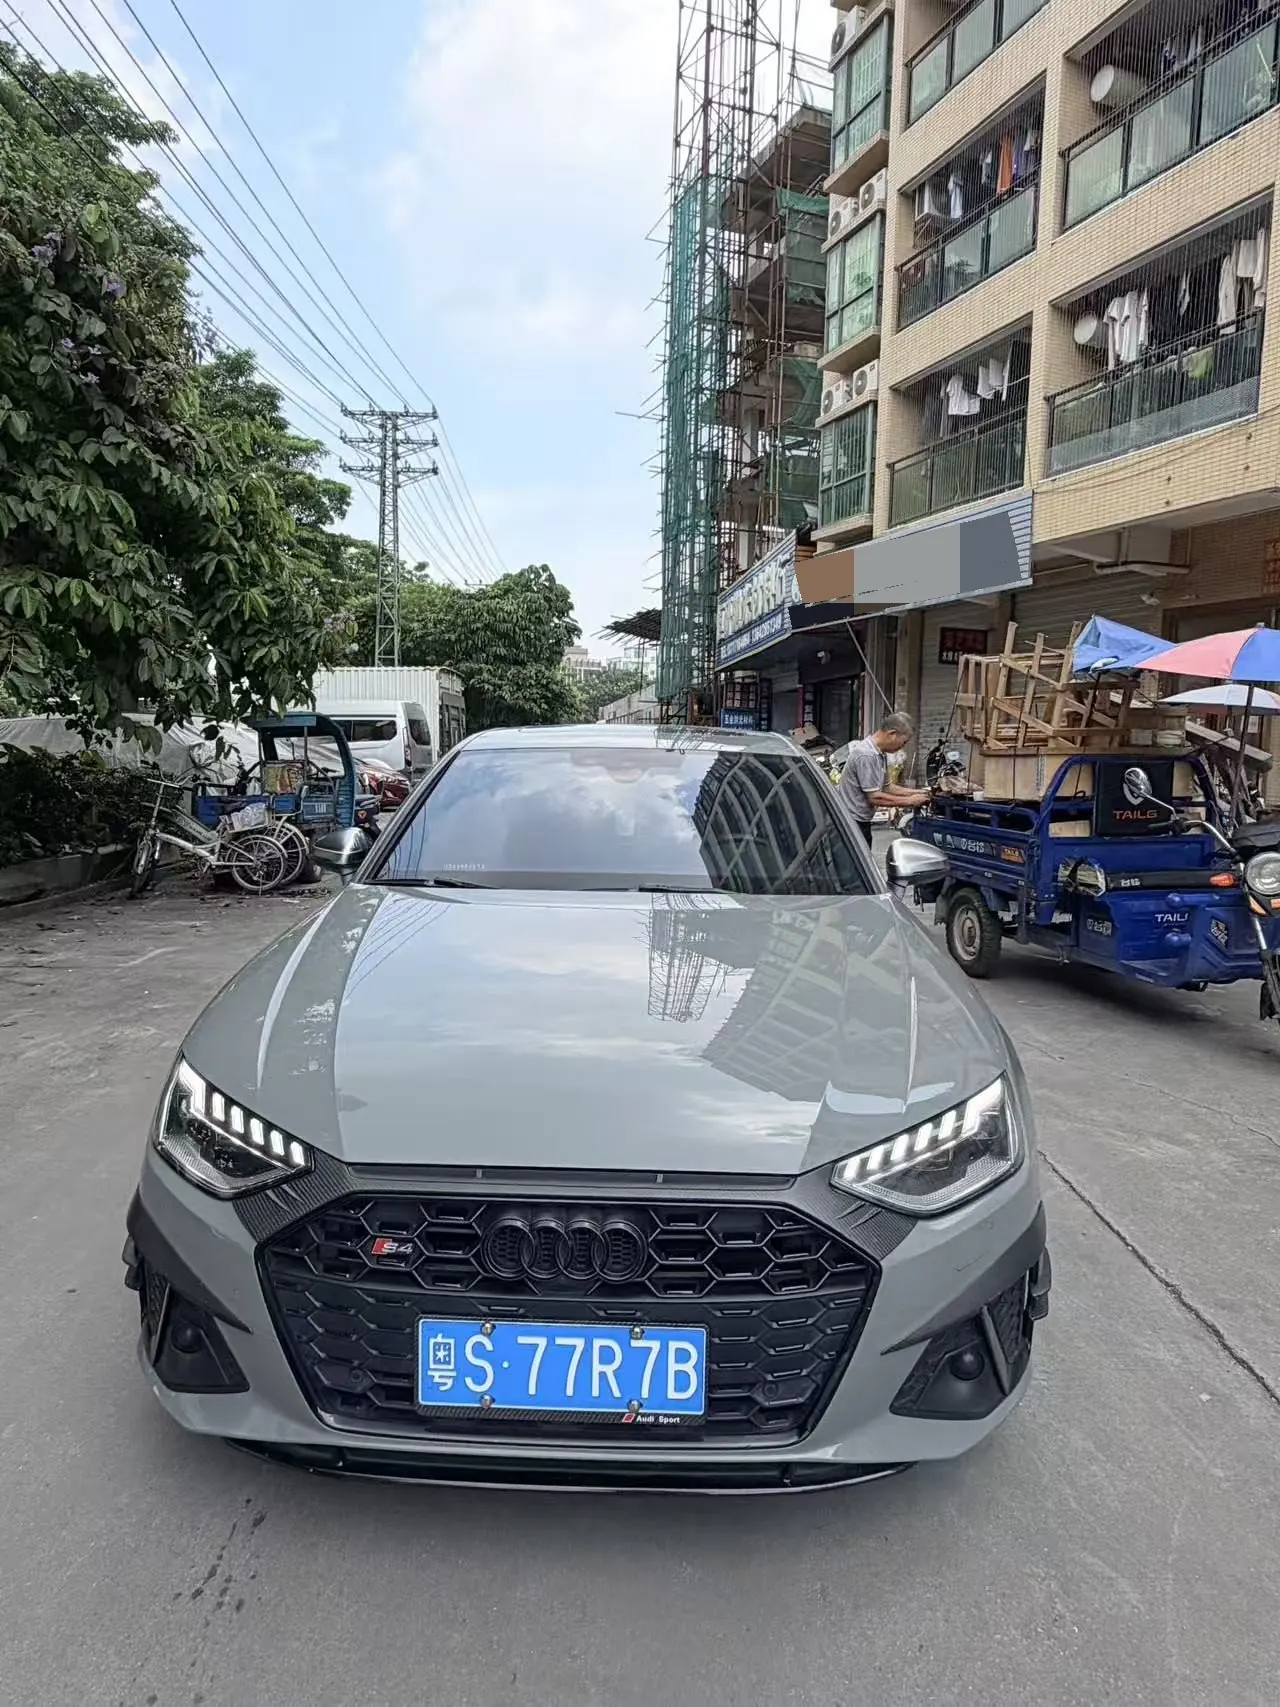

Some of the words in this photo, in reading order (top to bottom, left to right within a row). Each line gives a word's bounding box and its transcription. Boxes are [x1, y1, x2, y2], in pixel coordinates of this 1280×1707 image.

[1112, 809, 1158, 820] TAILG
[382, 1242, 413, 1254] S4
[427, 1332, 699, 1401] 粤S·77R7B
[636, 1415, 655, 1423] Audi
[658, 1415, 680, 1425] Sport
